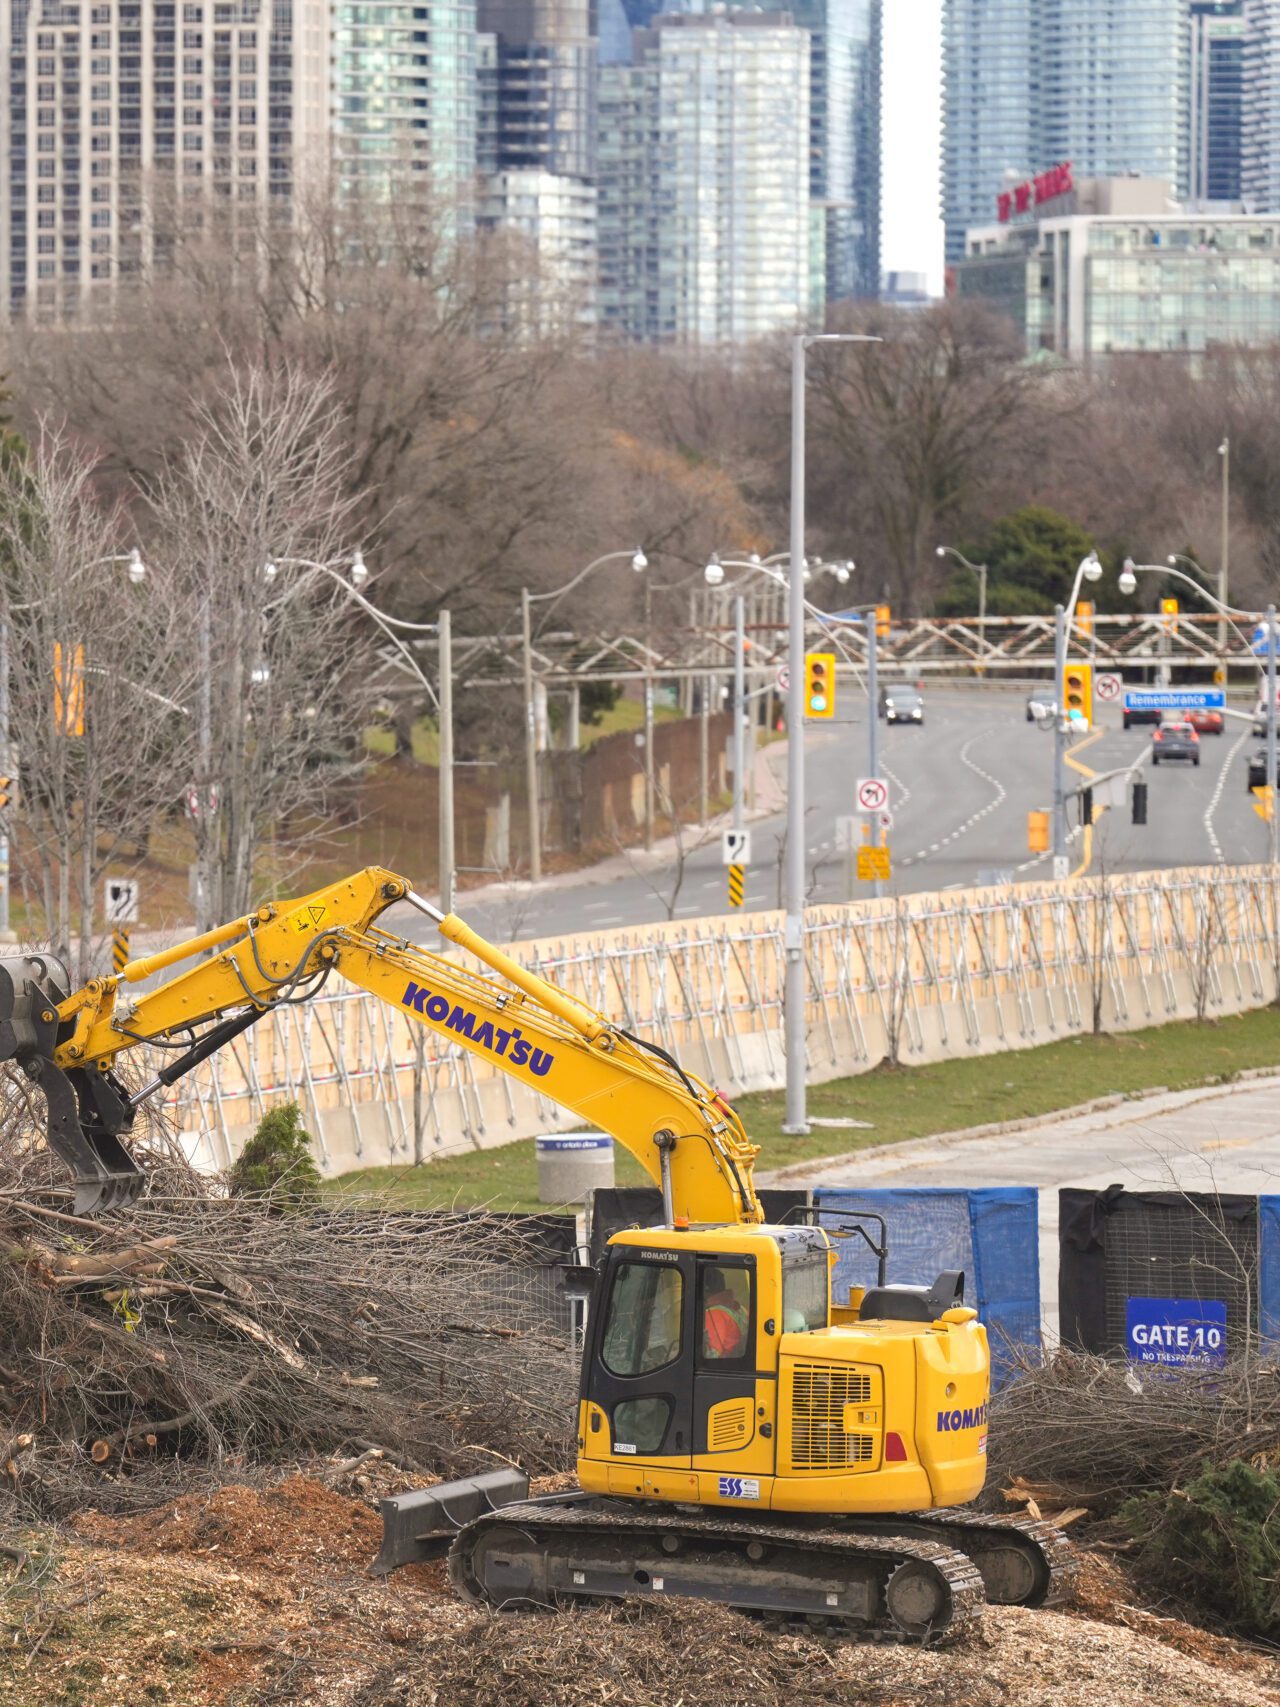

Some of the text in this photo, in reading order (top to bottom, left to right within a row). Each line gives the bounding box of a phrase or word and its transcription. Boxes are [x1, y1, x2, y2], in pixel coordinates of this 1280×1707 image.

[1129, 693, 1207, 706] Remembrance
[402, 981, 554, 1076] KOMATSU
[641, 1251, 679, 1261] KOMATSU
[1132, 1324, 1221, 1349] GATE 10
[1142, 1352, 1211, 1363] NO TRESPASING
